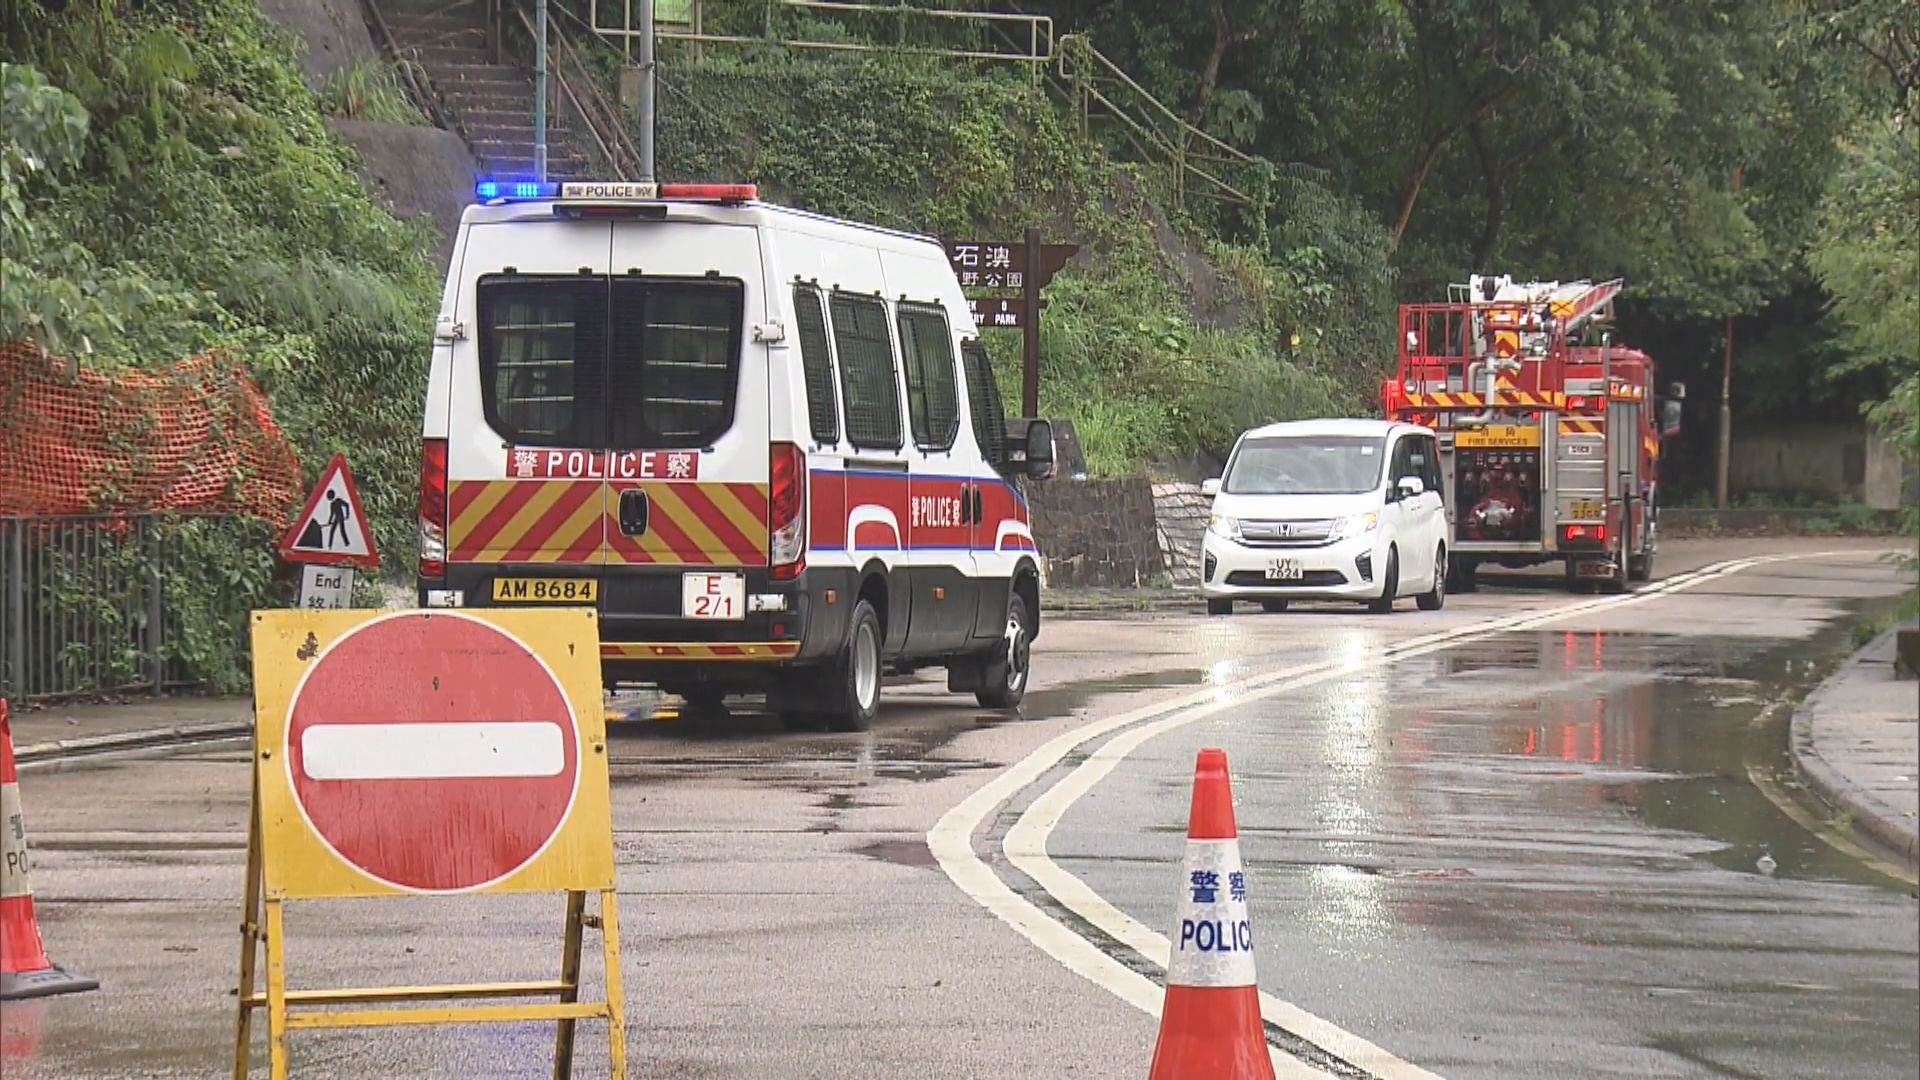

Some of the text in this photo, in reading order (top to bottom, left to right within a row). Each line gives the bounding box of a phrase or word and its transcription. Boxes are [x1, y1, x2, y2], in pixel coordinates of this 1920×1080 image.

[586, 186, 632, 197] POLICE
[953, 245, 1010, 268] 石澳
[955, 272, 1022, 287] 野公園
[995, 314, 1017, 325] PARK
[514, 451, 691, 478] 警 POLICE 察
[921, 496, 951, 528] POLICE
[1276, 558, 1291, 569] UY
[315, 574, 341, 589] End
[499, 578, 591, 599] AM 8684
[706, 576, 721, 595] E
[695, 596, 732, 616] 2/1
[7, 850, 29, 876] PO
